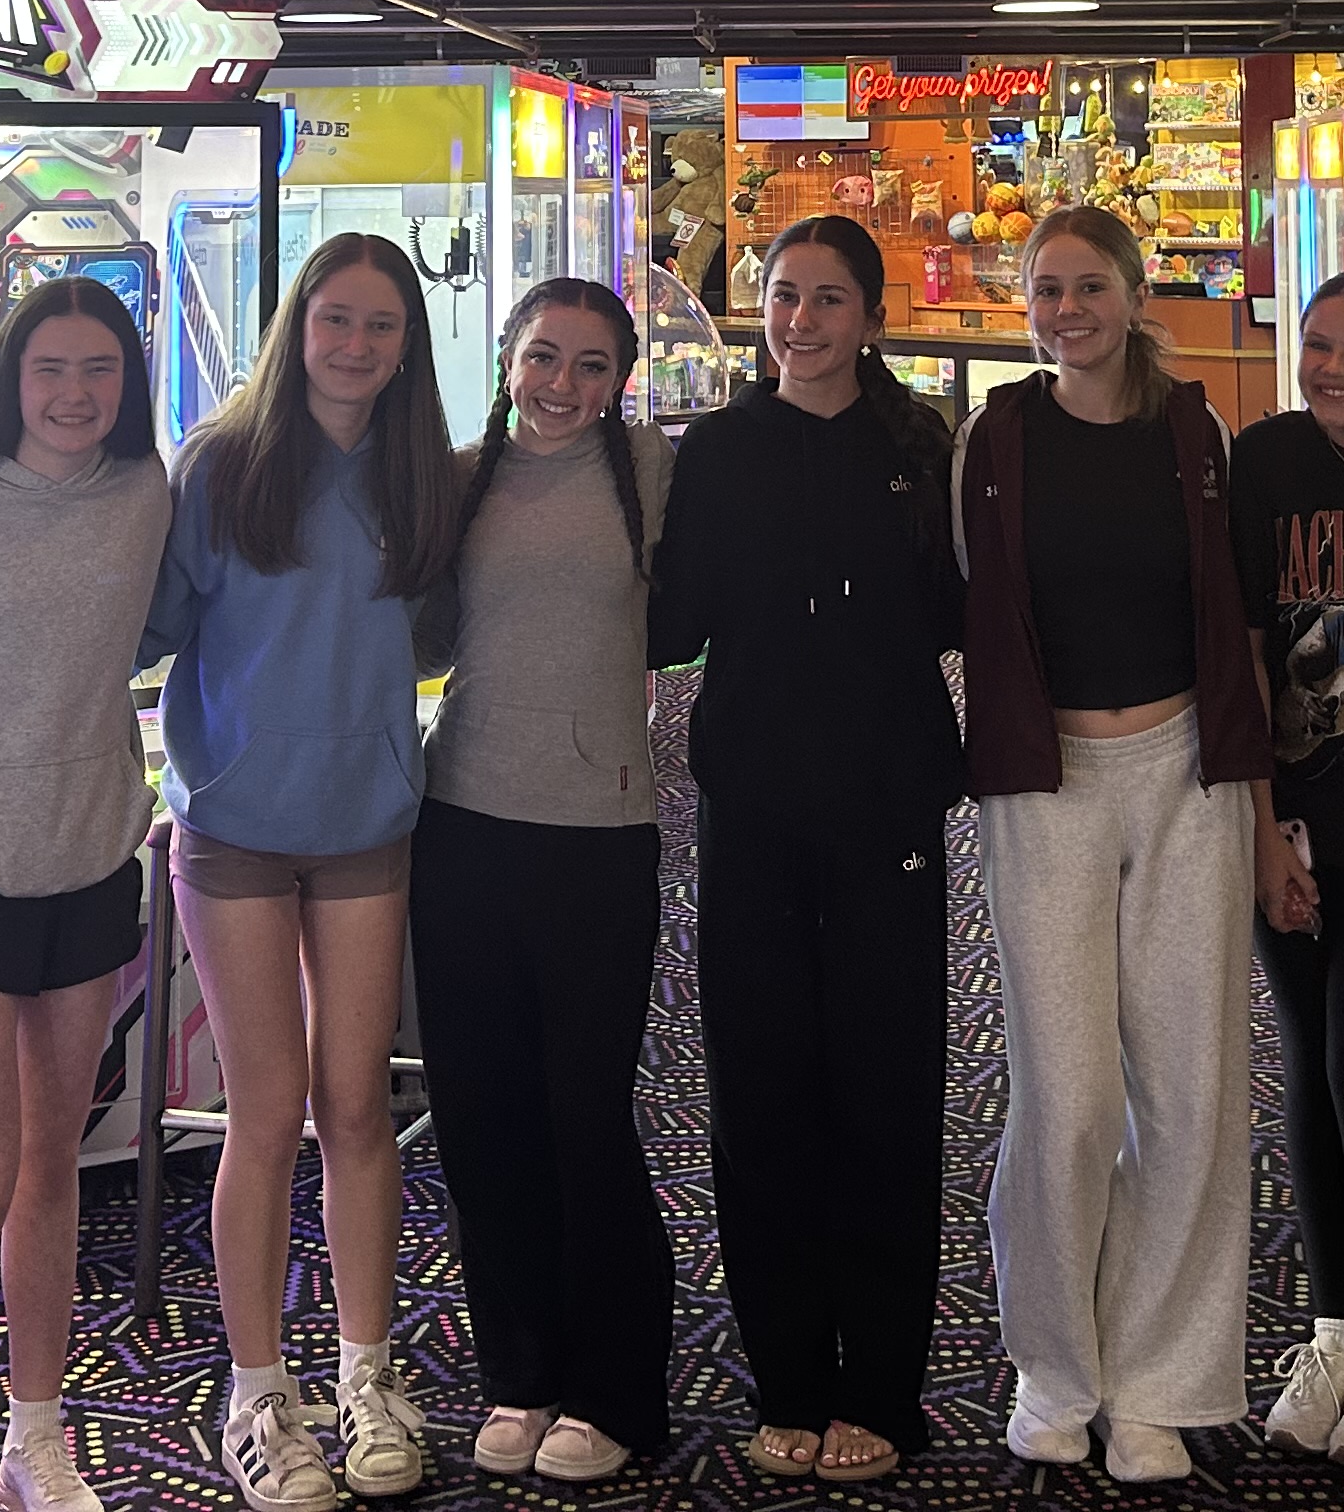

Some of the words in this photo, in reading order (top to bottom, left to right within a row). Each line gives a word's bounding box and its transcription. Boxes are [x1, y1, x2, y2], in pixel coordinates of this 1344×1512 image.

[854, 65, 897, 114] Get
[899, 75, 962, 113] your
[959, 59, 1054, 106] prizes!
[903, 852, 927, 872] alo
